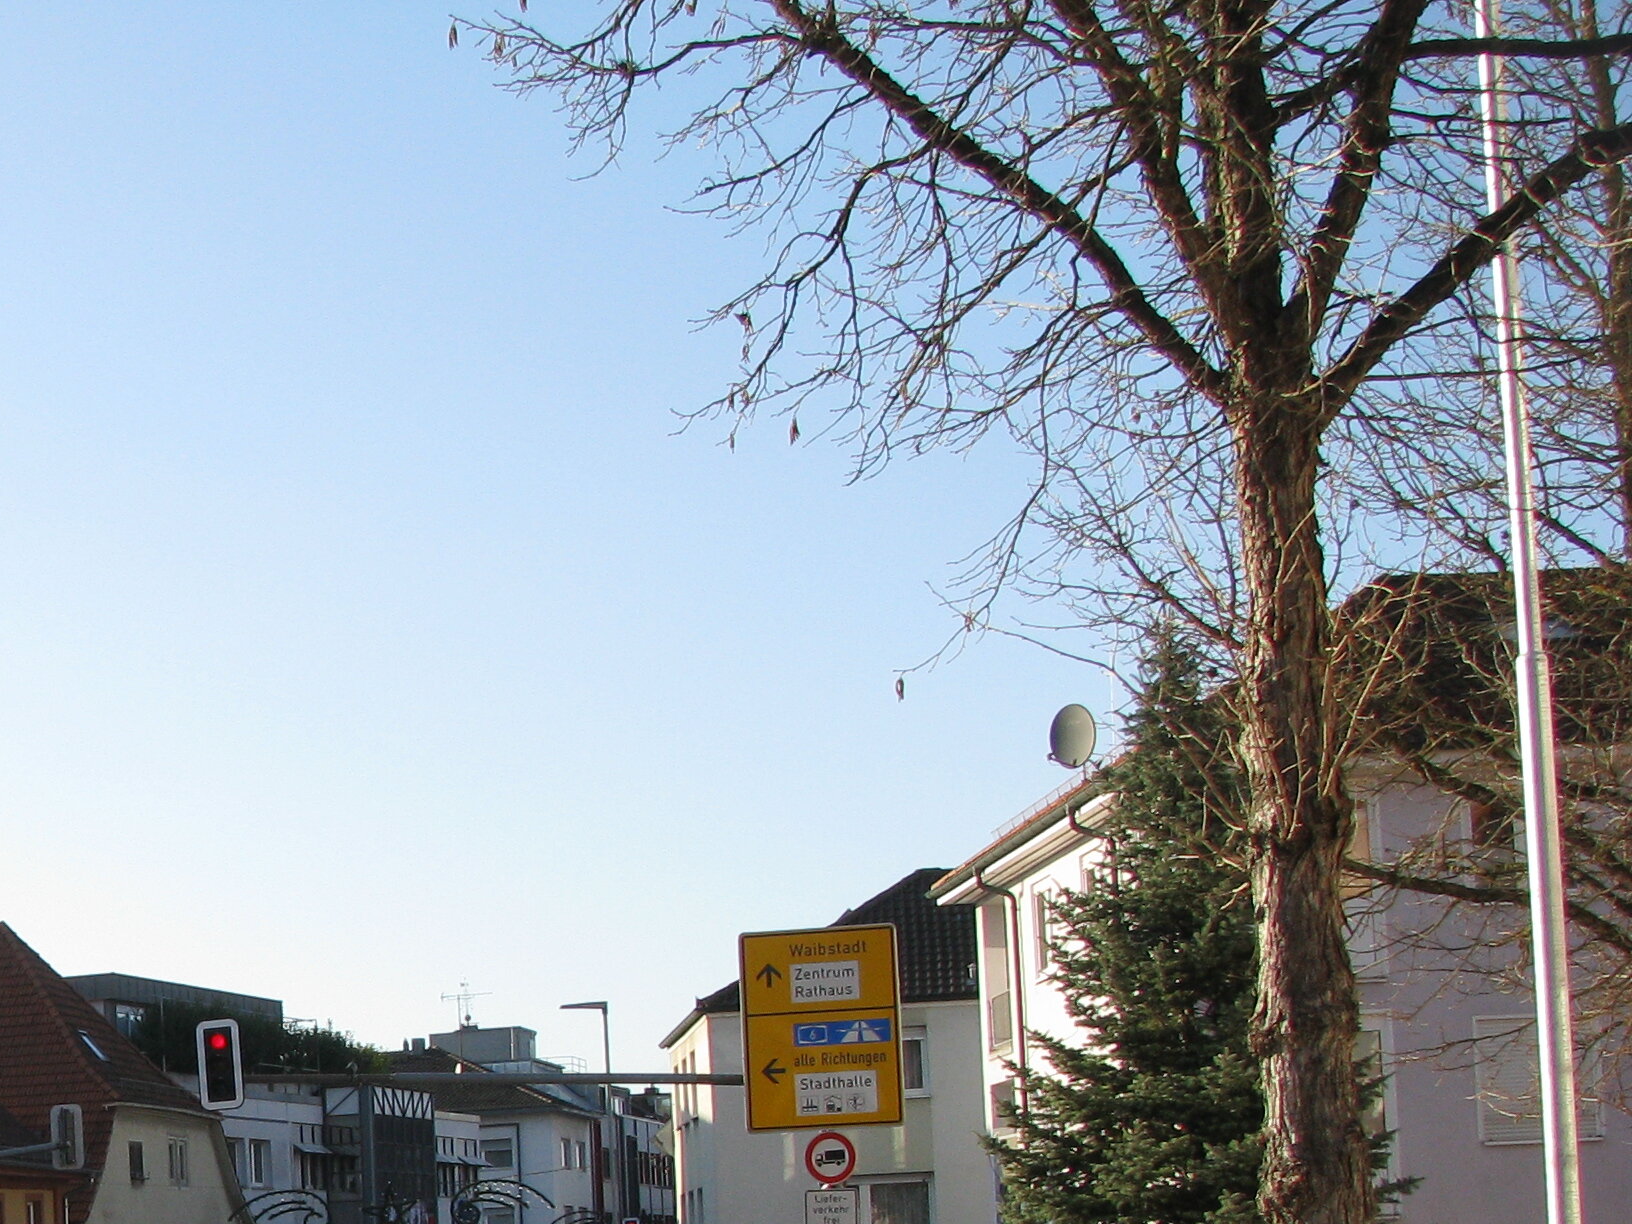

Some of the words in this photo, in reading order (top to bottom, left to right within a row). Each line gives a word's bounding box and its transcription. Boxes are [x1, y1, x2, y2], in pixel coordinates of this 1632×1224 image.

[789, 940, 867, 957] Waibstadt
[795, 968, 855, 981] Zentrum
[795, 985, 853, 998] Rathaus
[809, 1029, 817, 1040] 6
[794, 1054, 816, 1067] alle
[821, 1052, 887, 1067] Richtungen
[800, 1075, 872, 1091] Stadthalle
[814, 1194, 847, 1204] Liefer-
[813, 1206, 849, 1214] verkehr
[823, 1216, 840, 1224] frei
